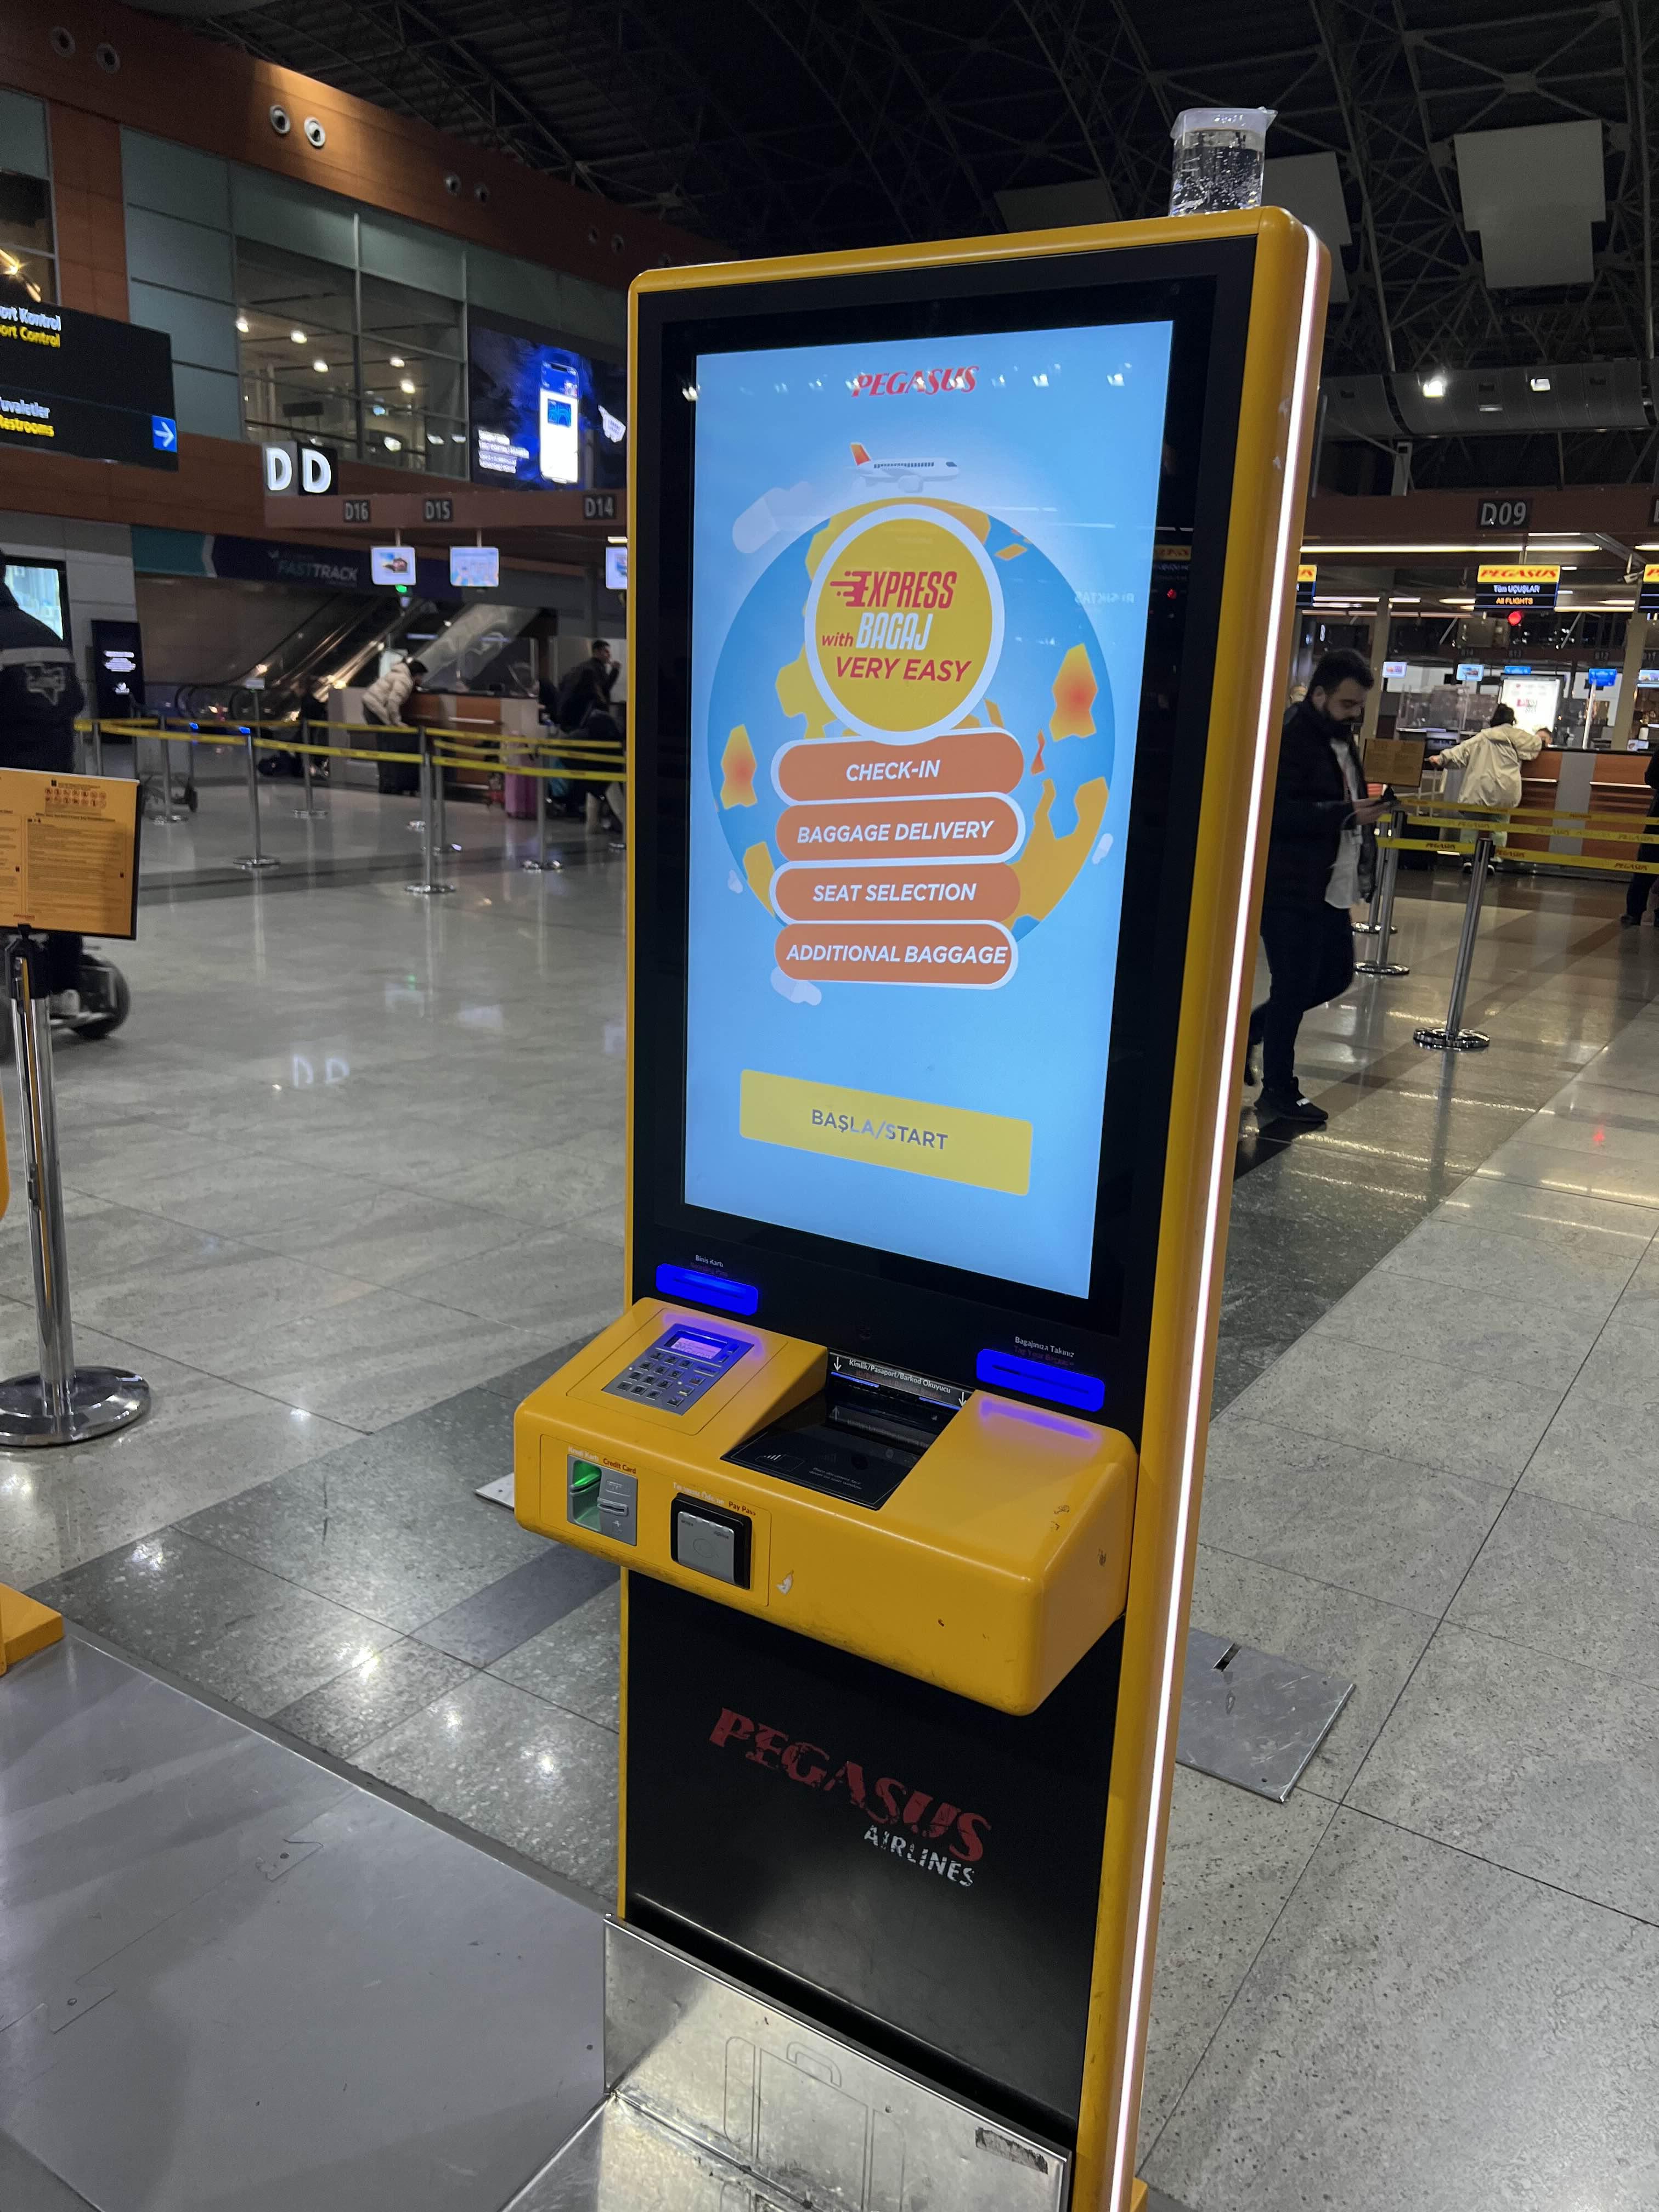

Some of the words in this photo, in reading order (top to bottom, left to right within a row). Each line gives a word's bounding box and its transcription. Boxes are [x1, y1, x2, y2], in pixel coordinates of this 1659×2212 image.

[19, 307, 61, 331] Kontrol
[19, 326, 60, 348] Control
[851, 366, 979, 398] PEGASUS
[0, 397, 50, 419] uvaletler
[345, 501, 370, 521] D16
[425, 500, 451, 520] D15
[585, 497, 614, 518] D14
[1481, 501, 1527, 527] D09
[1481, 569, 1556, 579] PEGASUS
[831, 571, 957, 608] EXPRESS
[821, 632, 854, 648] with
[856, 612, 933, 651] BAGAJ
[836, 657, 900, 680] VERY
[902, 659, 972, 683] EASY
[845, 759, 941, 782] CHECK-IN
[797, 823, 891, 844] BAGGAGE
[894, 820, 995, 841] DELIVERY
[812, 884, 862, 902] SEAT
[865, 883, 977, 902] SELECTION
[786, 945, 901, 963] ADDITIONAL
[904, 946, 1008, 965] BAGGAGE
[811, 1109, 949, 1151] BAŞLA/START
[849, 1359, 922, 1385] Kimlik/Pasaport/Barkod
[923, 1379, 951, 1394] Okuyucu
[603, 1458, 621, 1470] Credit
[622, 1464, 636, 1474] Card
[728, 1500, 741, 1511] Pay
[742, 1505, 757, 1516] Pass
[709, 1707, 992, 1862] PEGASUS
[864, 1825, 975, 1887] AIRLINES
